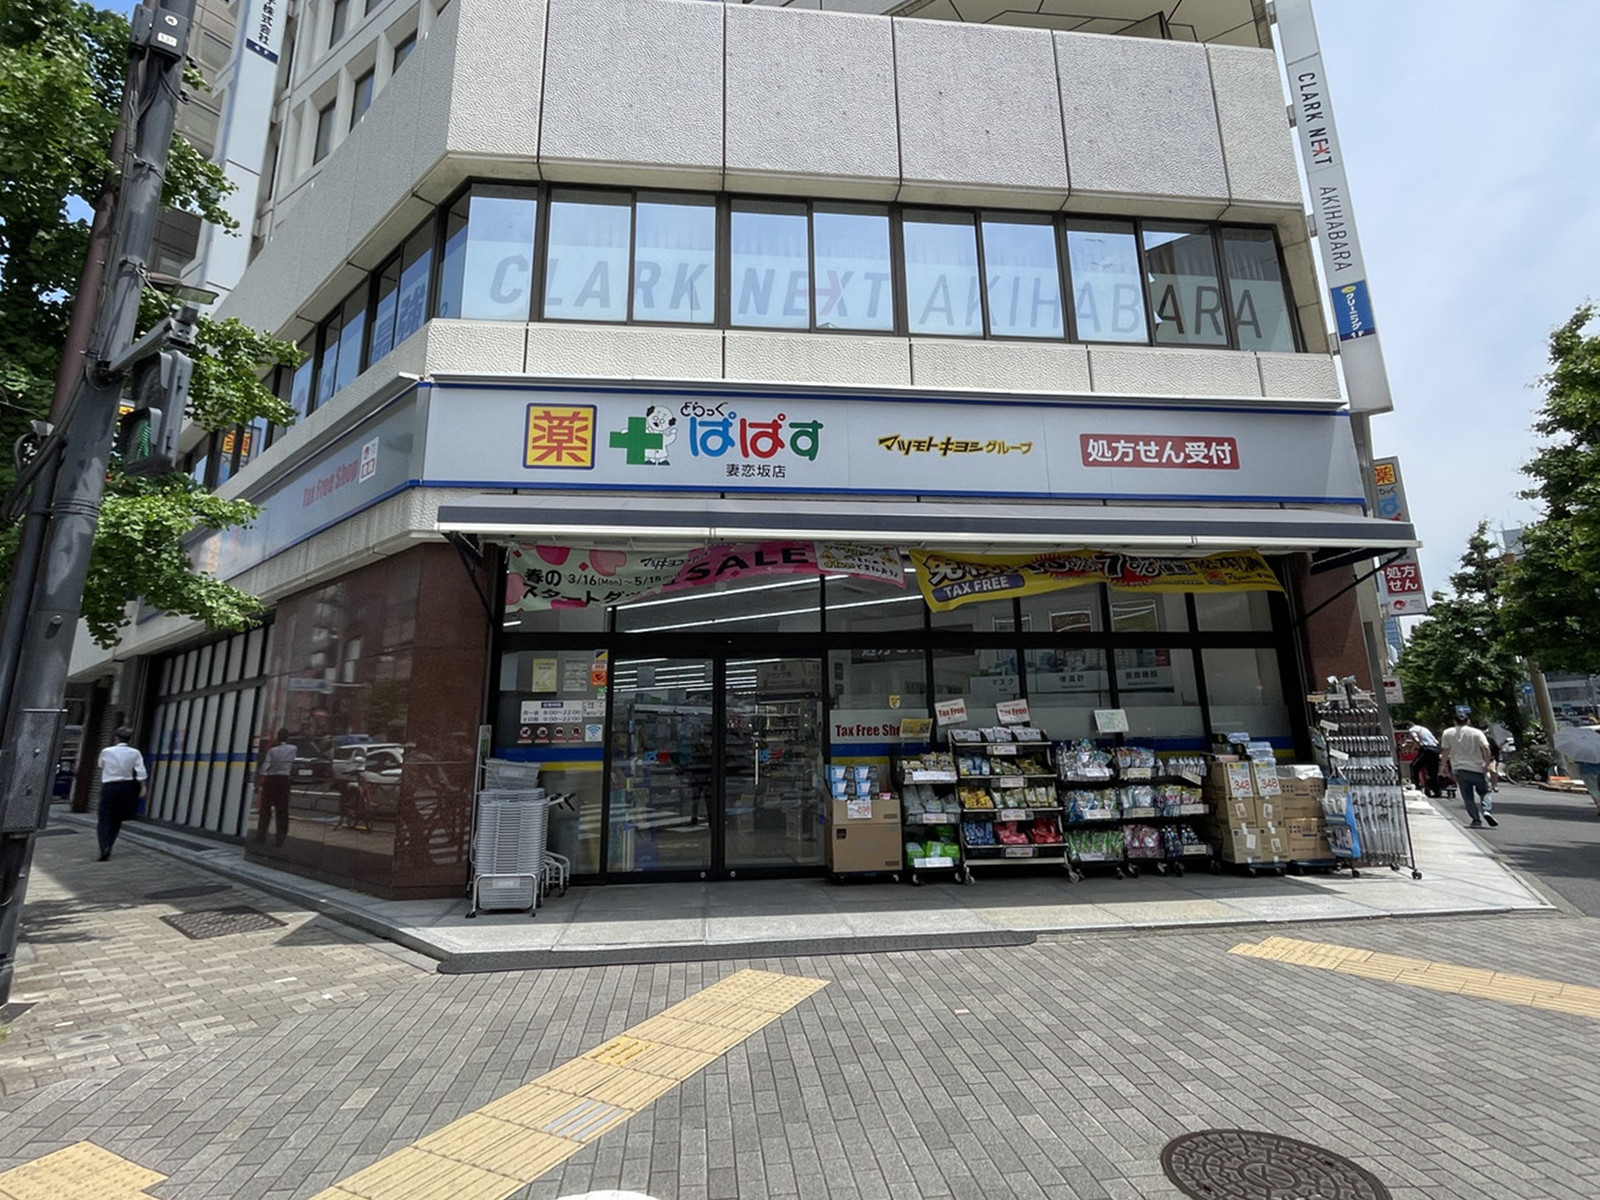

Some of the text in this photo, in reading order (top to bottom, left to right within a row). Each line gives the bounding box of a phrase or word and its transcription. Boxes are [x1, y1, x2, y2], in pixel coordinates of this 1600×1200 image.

[1298, 72, 1353, 272] CLARK NEXT AKIHABARA
[488, 254, 710, 312] CLARK
[737, 266, 890, 318] NEXT
[918, 274, 1263, 339] AKIHABARA
[680, 400, 729, 418] どらっぐ
[531, 410, 589, 464] 薬
[689, 410, 824, 461] ぱぱす
[877, 433, 1034, 457] マツモトキヨシグループ
[1086, 438, 1233, 466] 処方せん受付
[725, 463, 787, 479] 妻恋坂店
[686, 546, 810, 580] SALE
[1386, 565, 1415, 579] 処方
[524, 568, 562, 587] 春の
[943, 575, 1010, 599] TAX FREE
[1388, 578, 1418, 592] せん
[522, 582, 642, 606] スタートダ
[938, 707, 965, 718] Tax Free
[835, 724, 854, 737] Tax
[856, 724, 880, 737] Free
[882, 723, 901, 737] Sho
